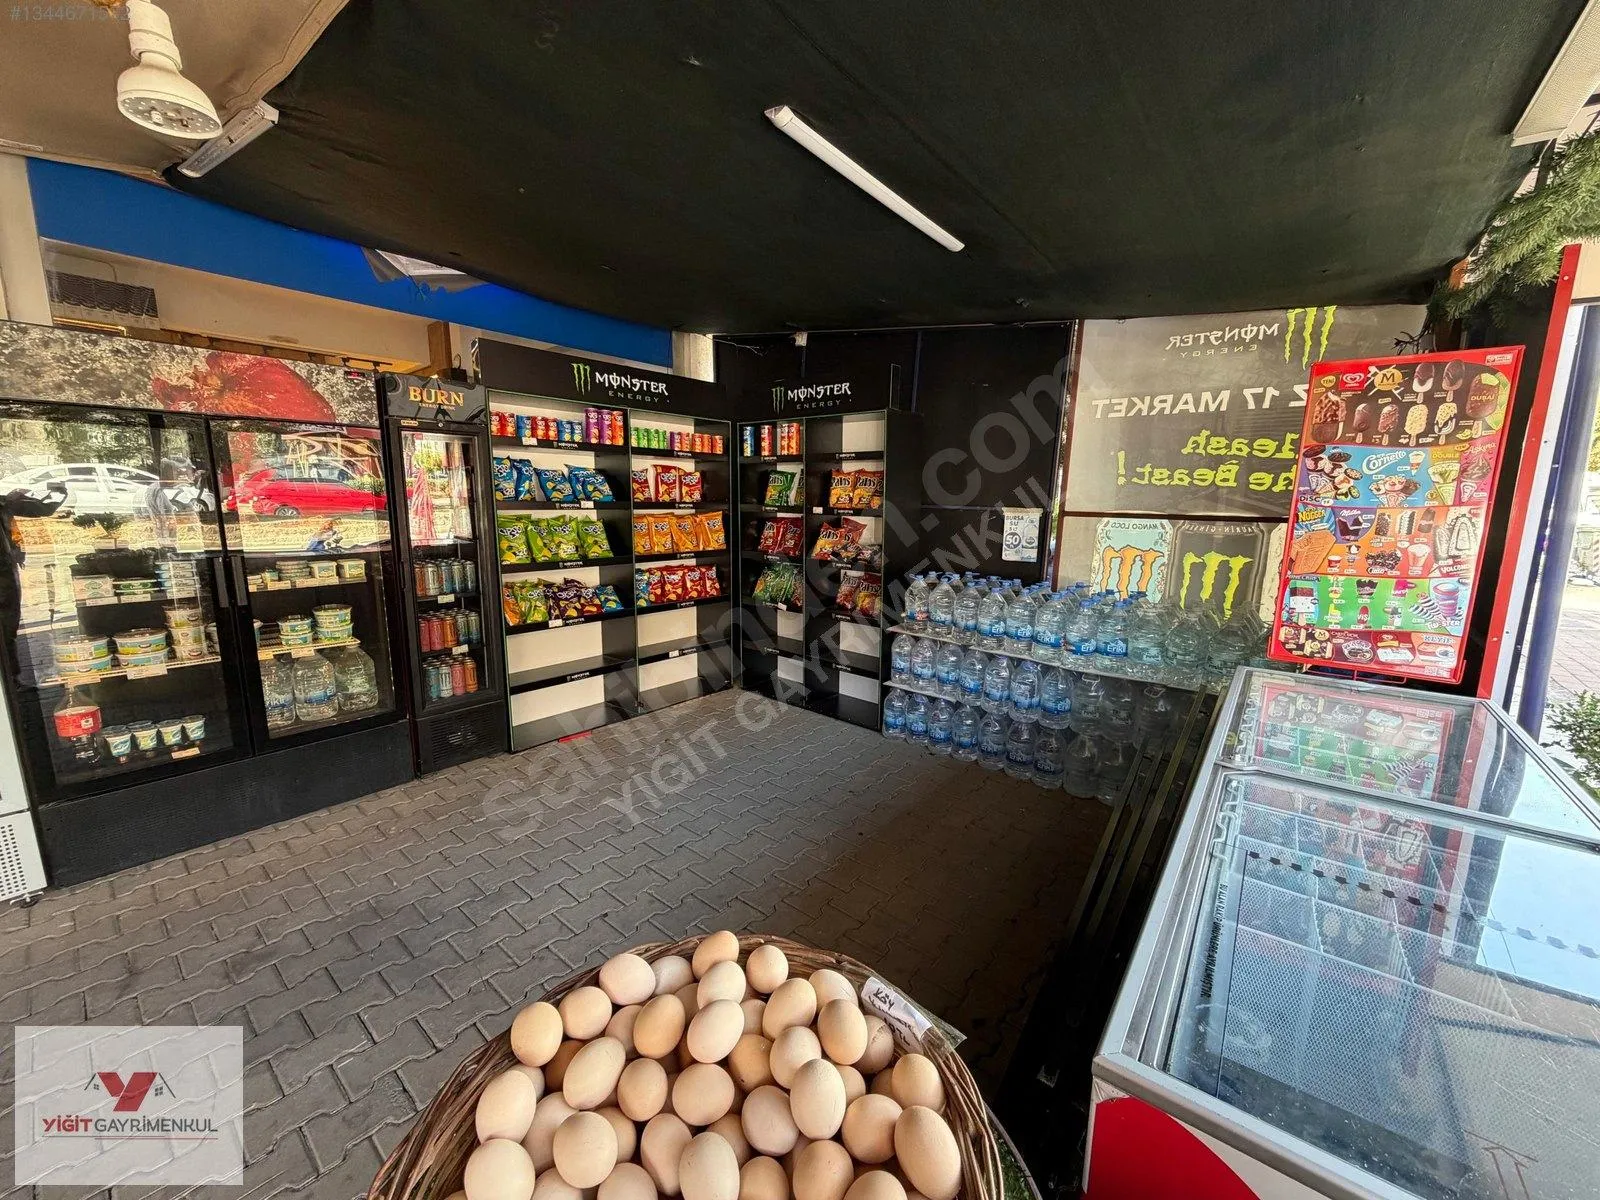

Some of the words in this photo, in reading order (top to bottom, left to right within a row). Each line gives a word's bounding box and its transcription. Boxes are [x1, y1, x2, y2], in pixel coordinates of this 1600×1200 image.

[595, 371, 669, 396] MONSTER
[787, 382, 851, 402] MONSTER
[408, 386, 464, 407] BURN
[608, 390, 659, 403] ENERGY
[796, 399, 841, 410] ENERGY
[1362, 450, 1406, 475] Cornetto
[1005, 535, 1019, 545] 50
